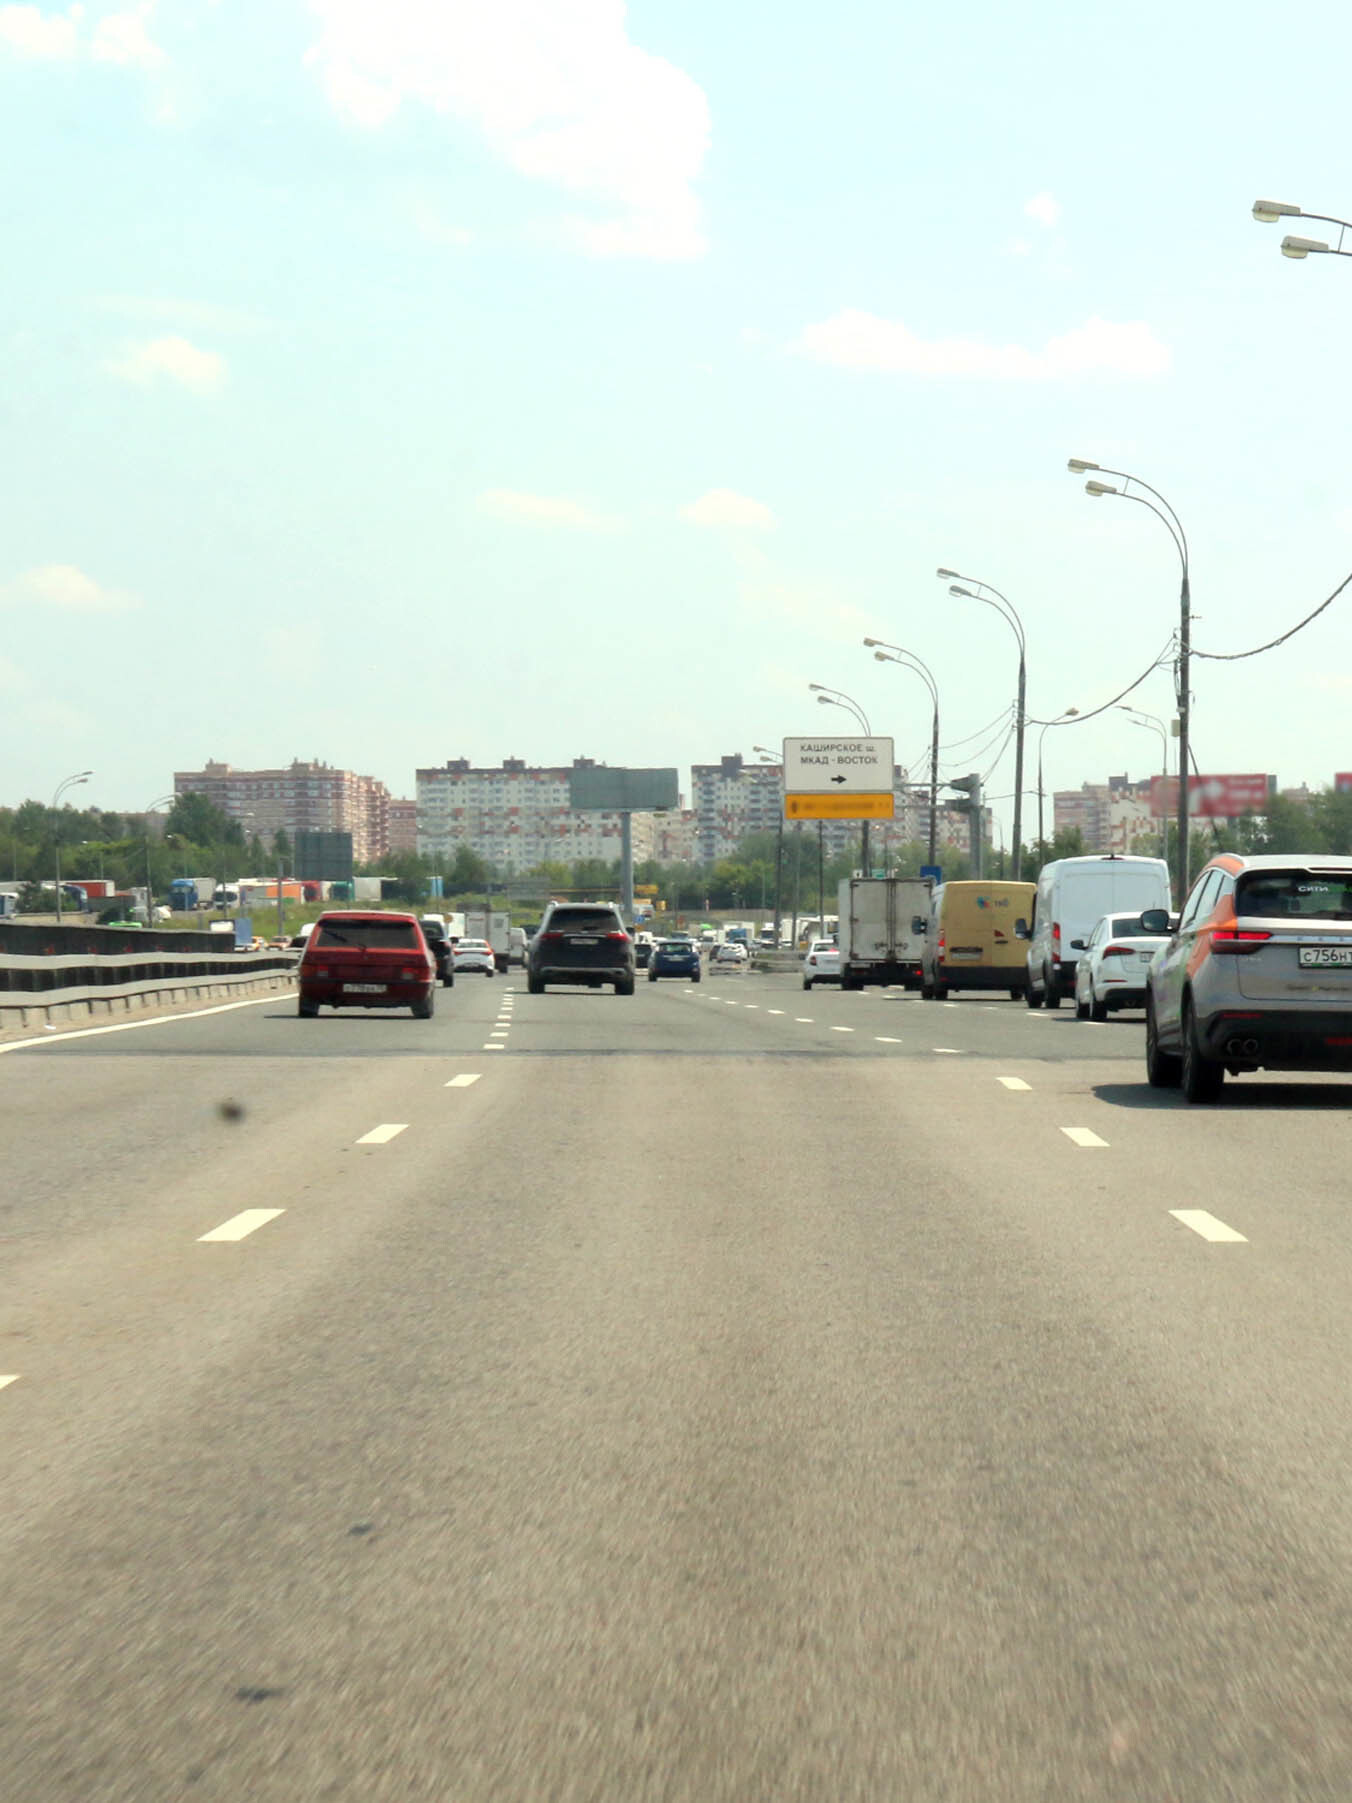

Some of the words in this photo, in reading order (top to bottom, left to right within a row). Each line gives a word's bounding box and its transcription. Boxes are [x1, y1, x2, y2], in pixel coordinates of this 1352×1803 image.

[800, 743, 864, 752] КАШИРСКОЕ
[800, 756, 829, 765] МКАД
[837, 755, 878, 765] ВОСТОК
